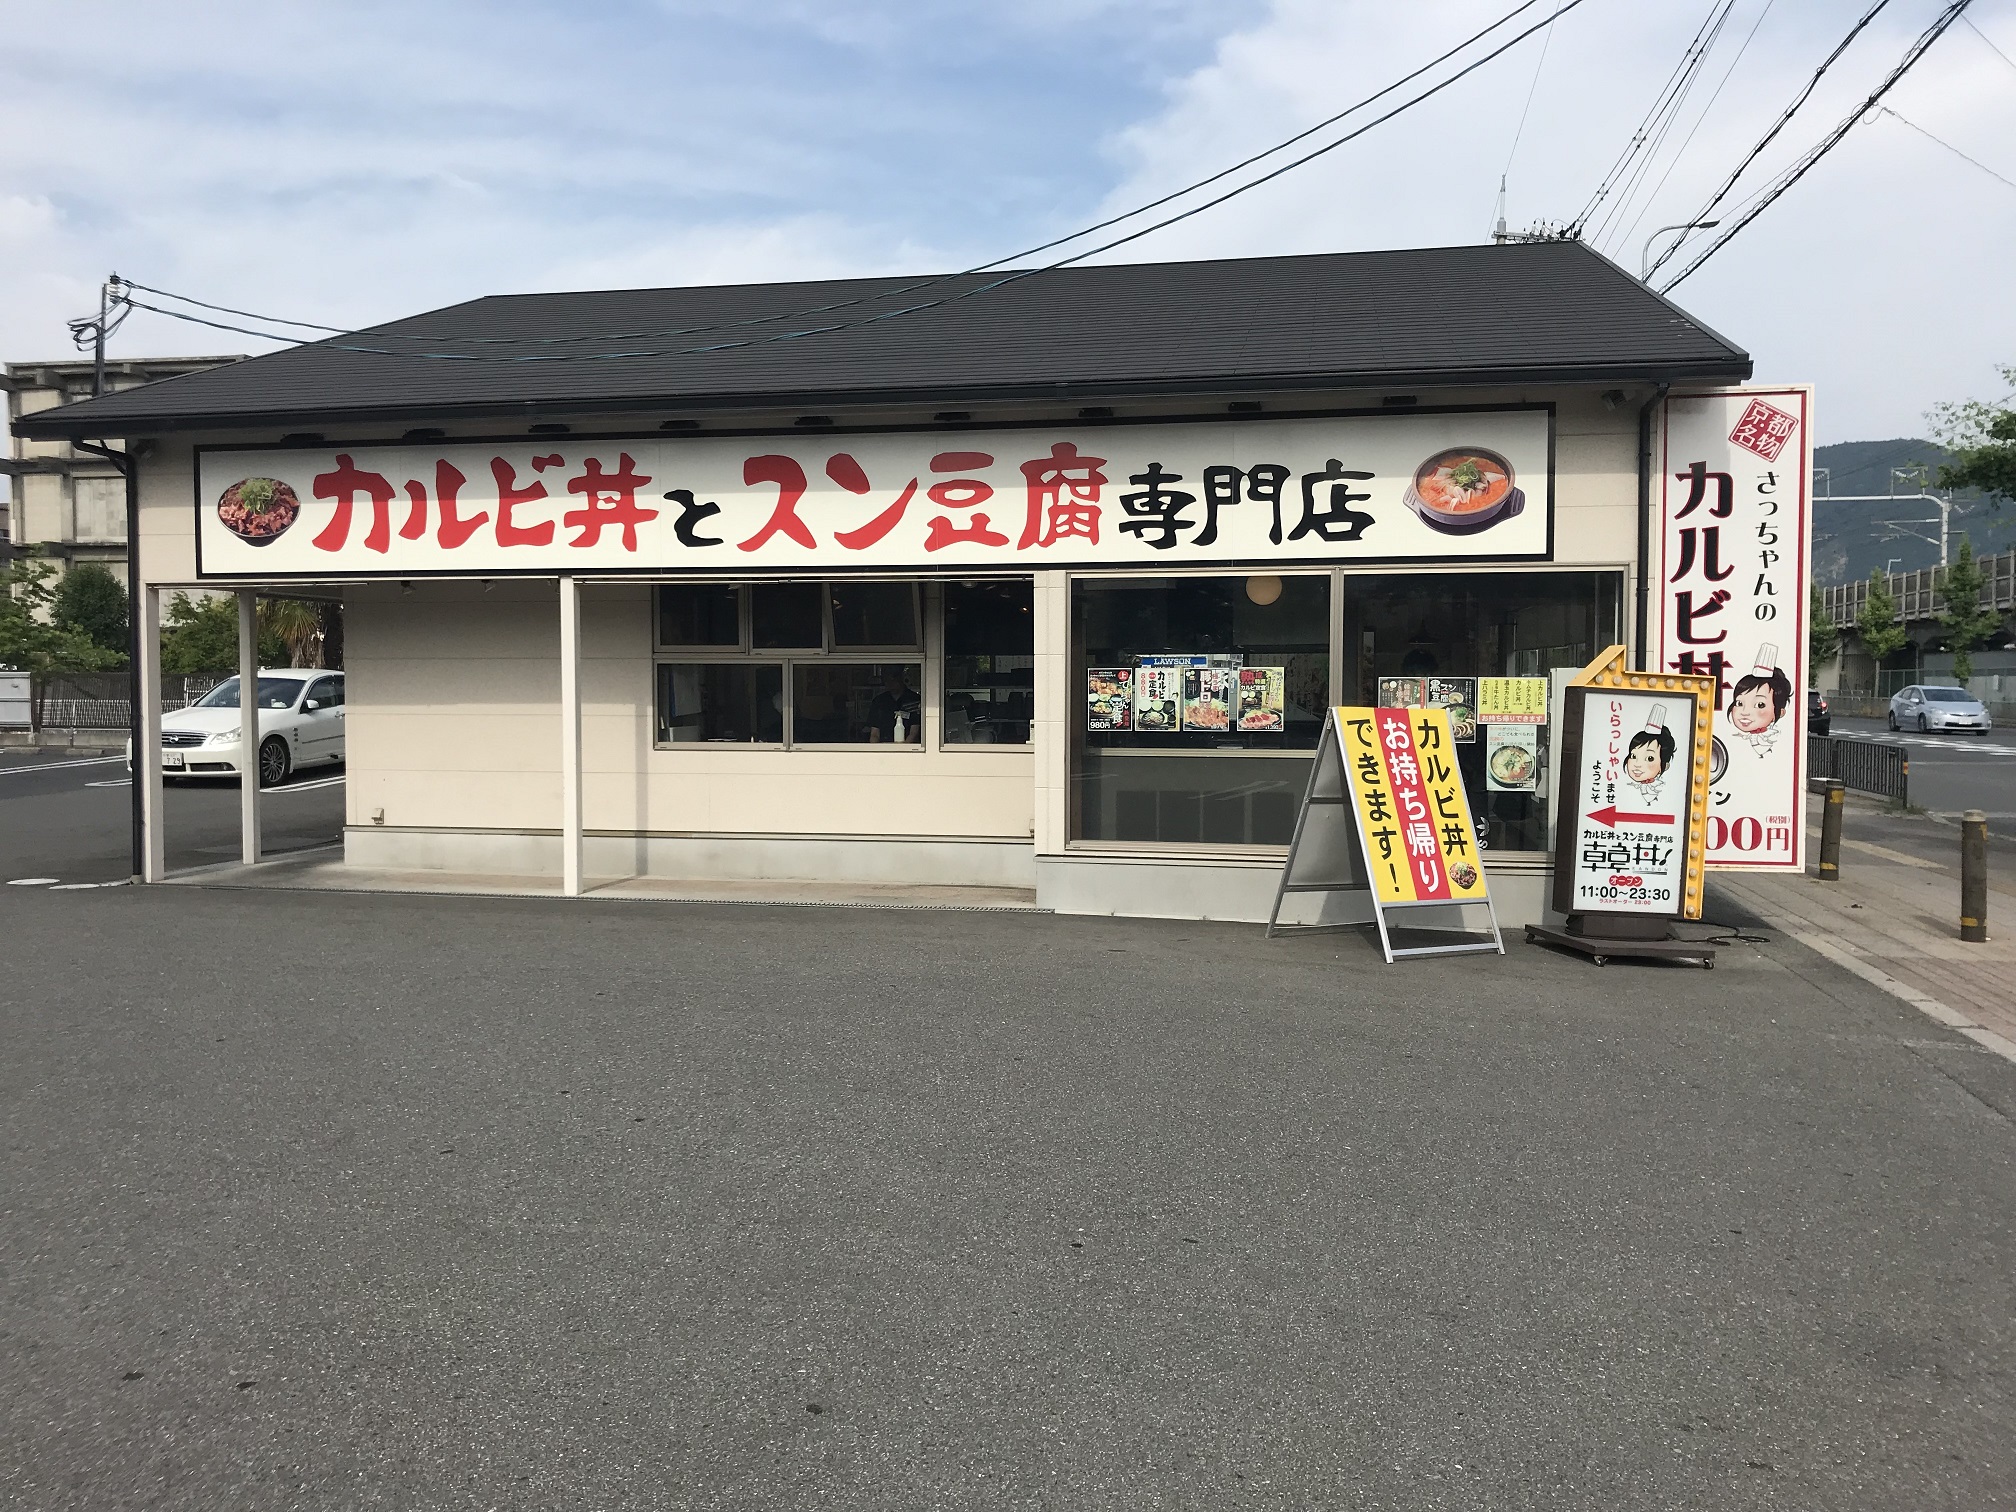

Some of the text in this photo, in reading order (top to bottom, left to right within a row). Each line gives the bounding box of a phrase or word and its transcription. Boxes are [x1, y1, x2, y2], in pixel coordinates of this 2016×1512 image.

[311, 442, 1376, 552] カルビ丼とスン豆腐専門店
[1753, 471, 1780, 622] さっちゃんの
[1154, 657, 1191, 665] LAWSON
[1157, 670, 1167, 699] カルビ
[1090, 721, 1111, 729] 980円
[1481, 714, 1543, 722] お持ち帰りできます
[1605, 700, 1623, 804] いらっしゃいませ
[1417, 718, 1468, 857] カルビ丼
[1590, 760, 1602, 804] ようこそ
[1383, 717, 1440, 893] お持ち帰り
[1610, 877, 1642, 886] オープン
